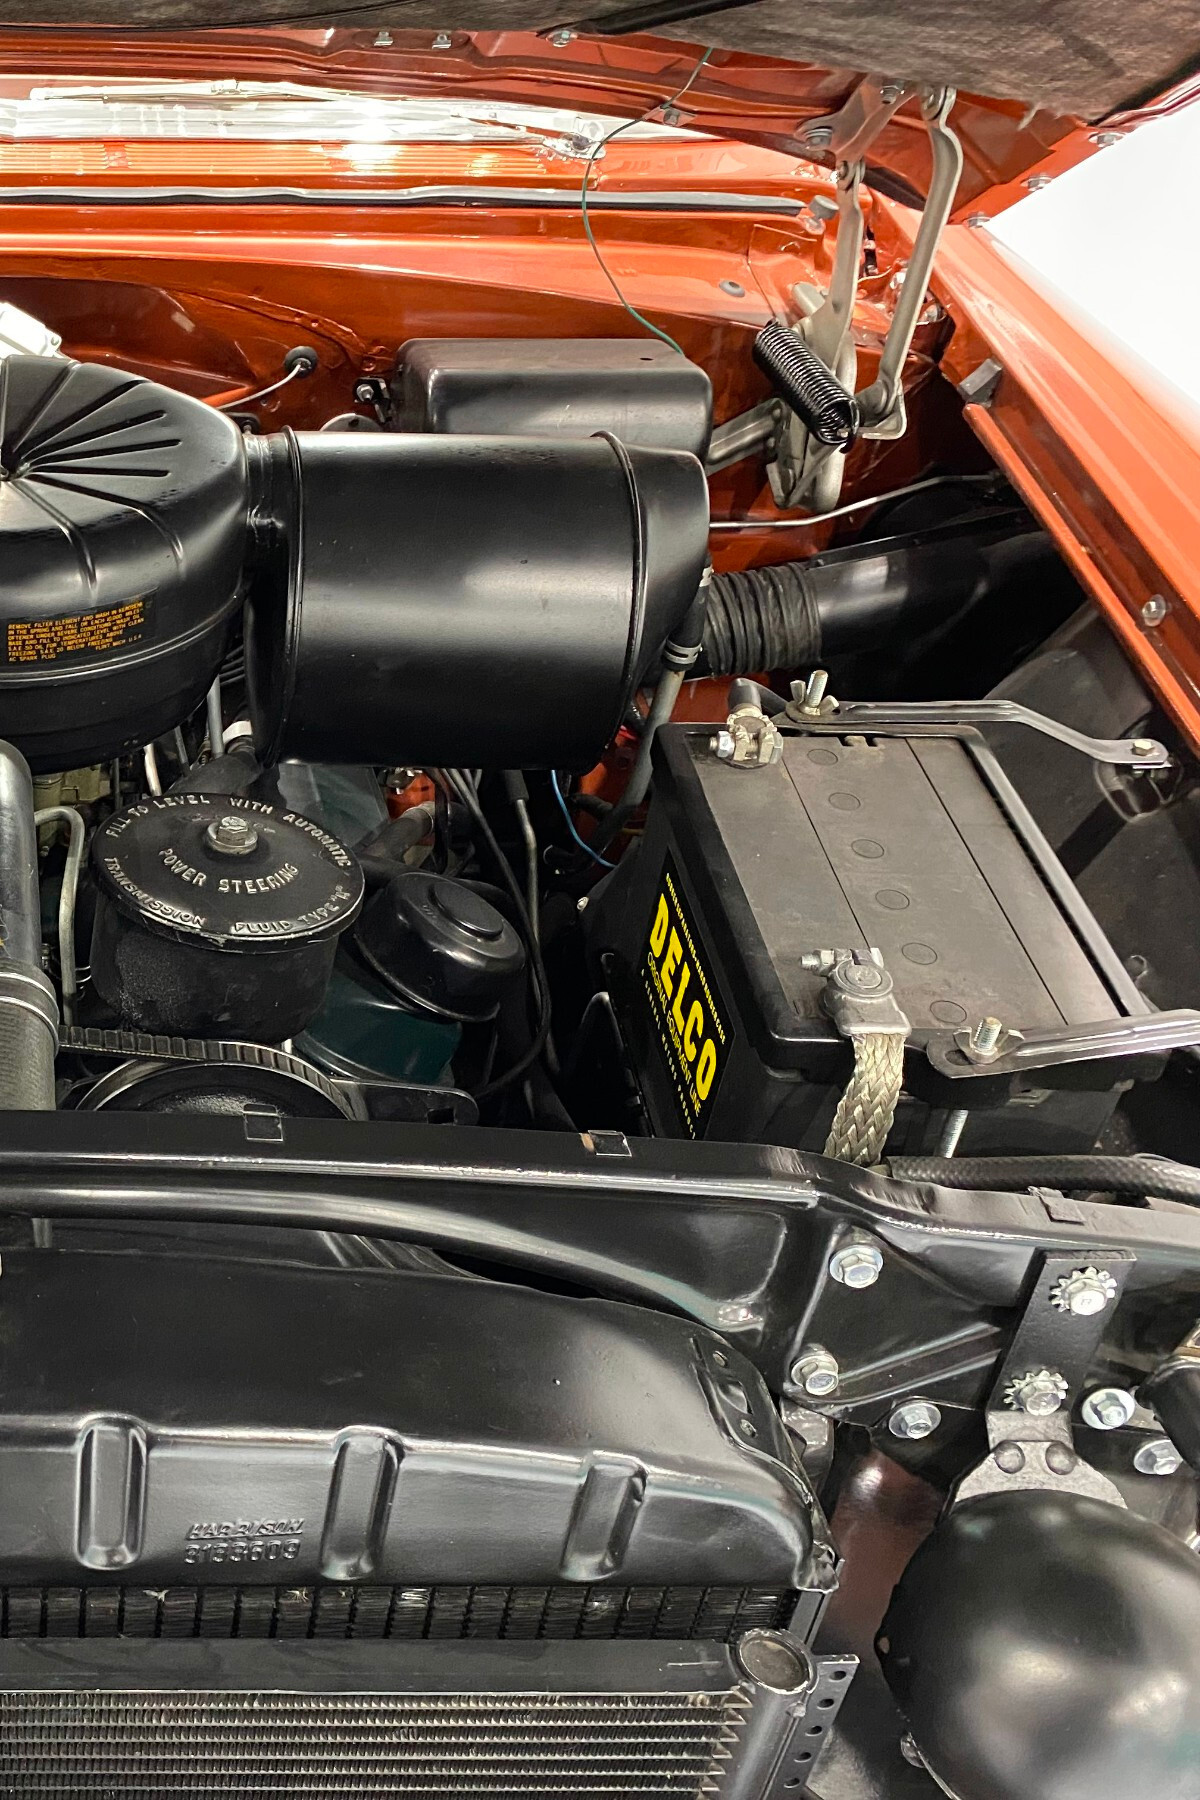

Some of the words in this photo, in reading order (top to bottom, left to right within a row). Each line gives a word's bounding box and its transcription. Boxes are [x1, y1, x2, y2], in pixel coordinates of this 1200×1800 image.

[106, 817, 131, 837] FILL
[128, 805, 148, 816] TO
[153, 795, 210, 808] LEVEL
[230, 798, 273, 814] WITH
[283, 814, 351, 866] AUTOMATIC
[104, 857, 205, 926] TRANSMISSION
[233, 920, 292, 933] FLUID
[298, 902, 340, 925] TYPE
[158, 848, 206, 886] POWER
[218, 862, 298, 894] STEERING
[648, 952, 667, 1014] ORIGINAL
[667, 1010, 691, 1084] EQUIPMENT
[690, 1083, 701, 1117] LINE
[650, 893, 716, 1100] DELCO
